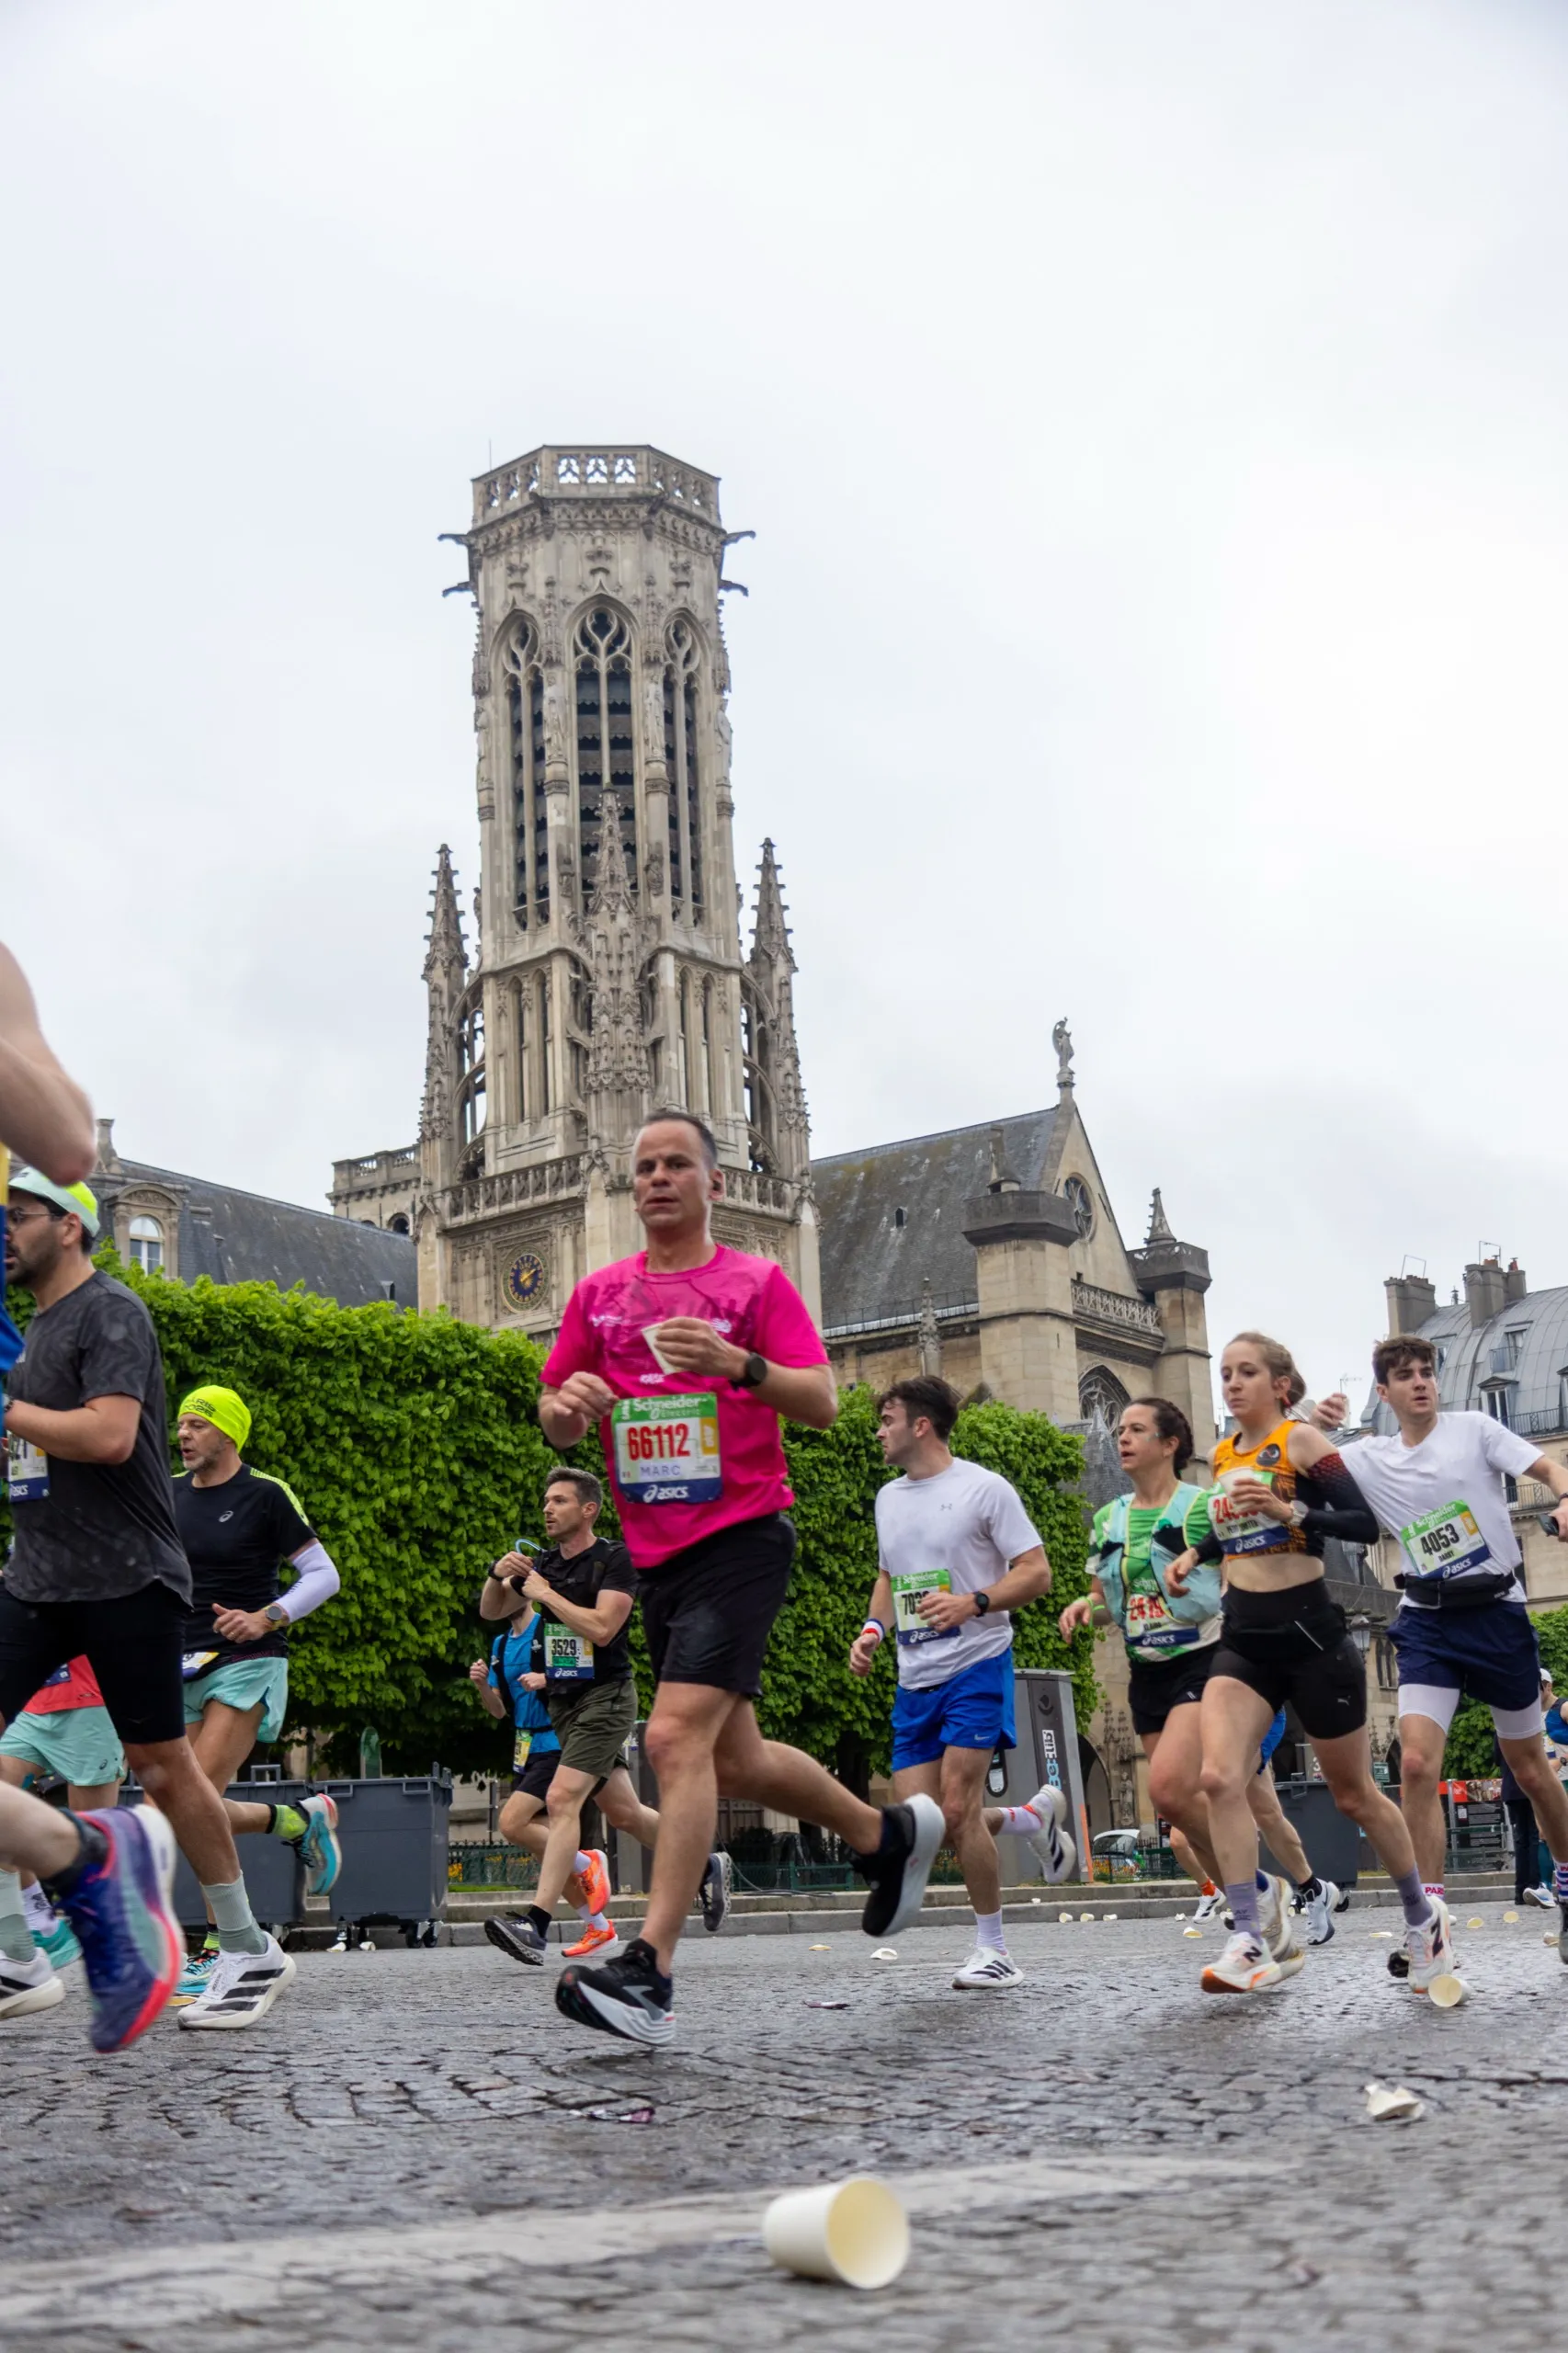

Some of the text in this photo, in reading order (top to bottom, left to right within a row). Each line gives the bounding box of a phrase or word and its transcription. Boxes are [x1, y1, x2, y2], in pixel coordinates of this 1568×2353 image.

[627, 1423, 690, 1461] 66112
[640, 1464, 681, 1478] MARC
[1420, 1522, 1460, 1556] 4053
[551, 1639, 576, 1656] 3529
